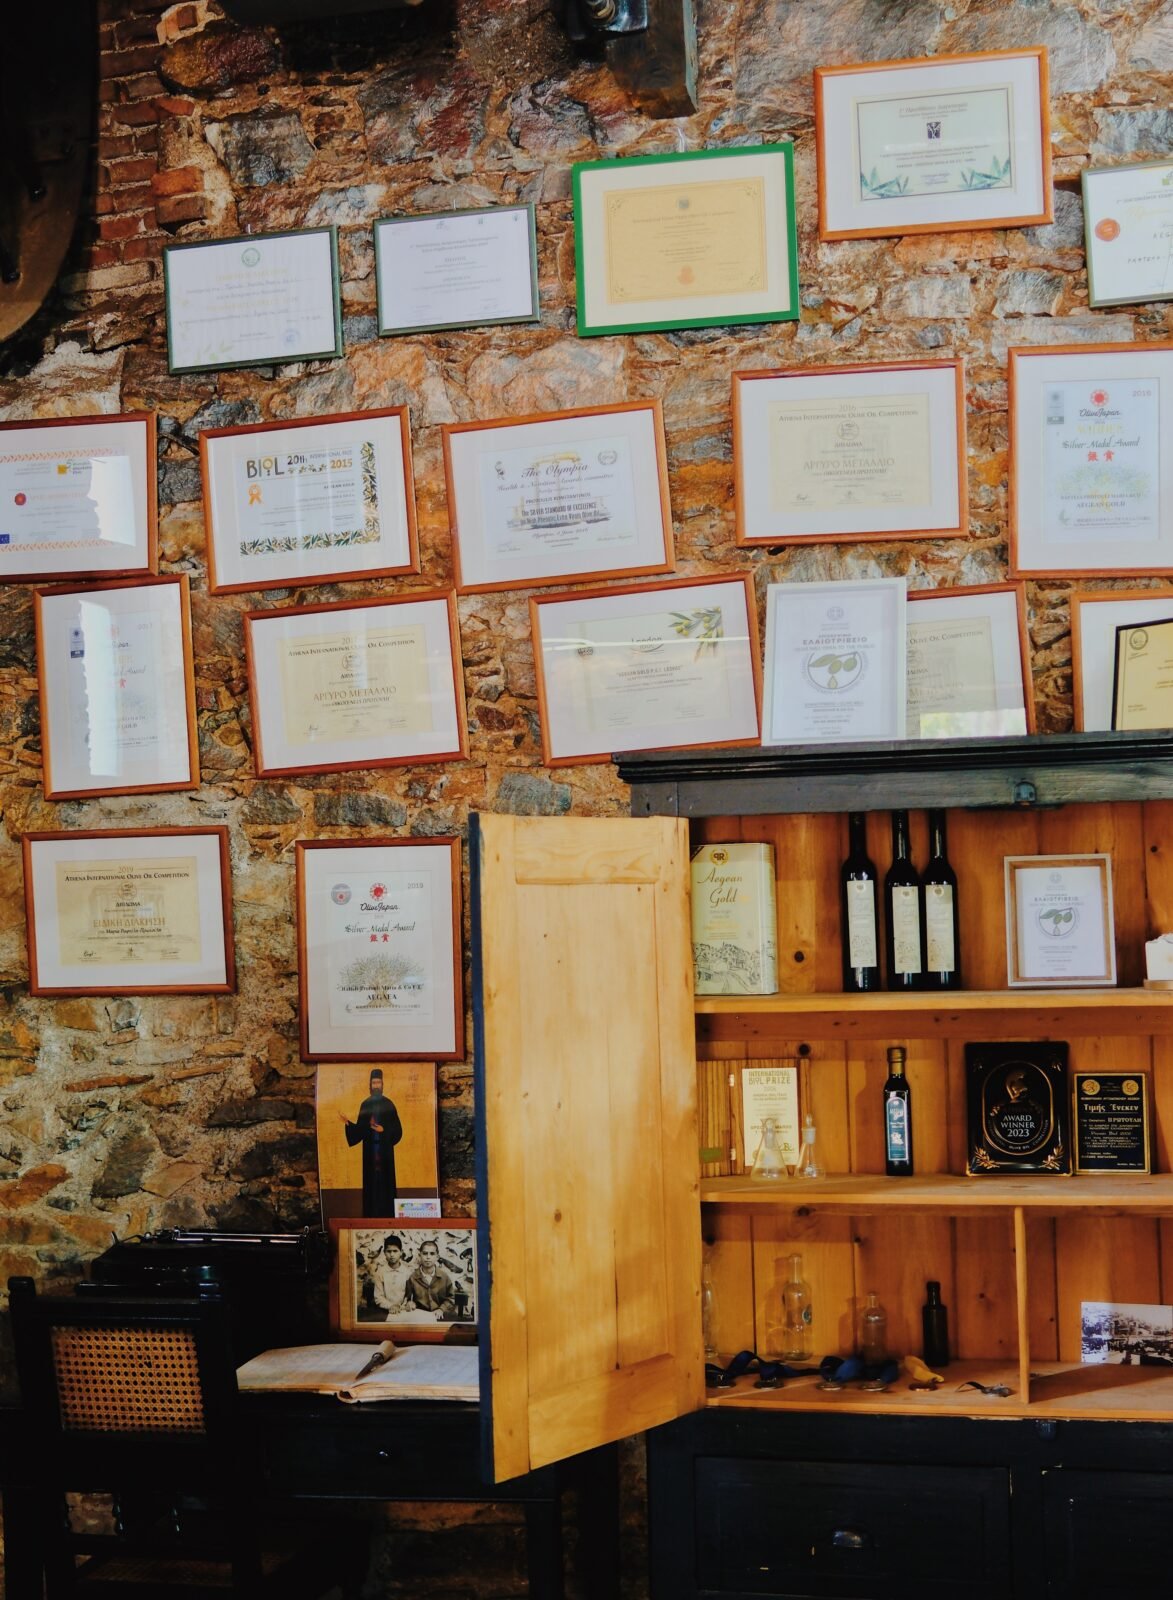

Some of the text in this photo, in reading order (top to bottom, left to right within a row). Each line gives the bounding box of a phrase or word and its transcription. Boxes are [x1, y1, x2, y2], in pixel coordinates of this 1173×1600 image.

[329, 458, 352, 470] 2015
[545, 463, 588, 478] Olympia
[697, 867, 743, 886] Aegean
[709, 888, 737, 909] Gold
[766, 1076, 791, 1085] PRIZE
[1083, 1103, 1106, 1113] Τιμής
[1002, 1114, 1032, 1122] AWARD
[1000, 1121, 1036, 1129] WINNER
[1007, 1128, 1030, 1137] 2023
